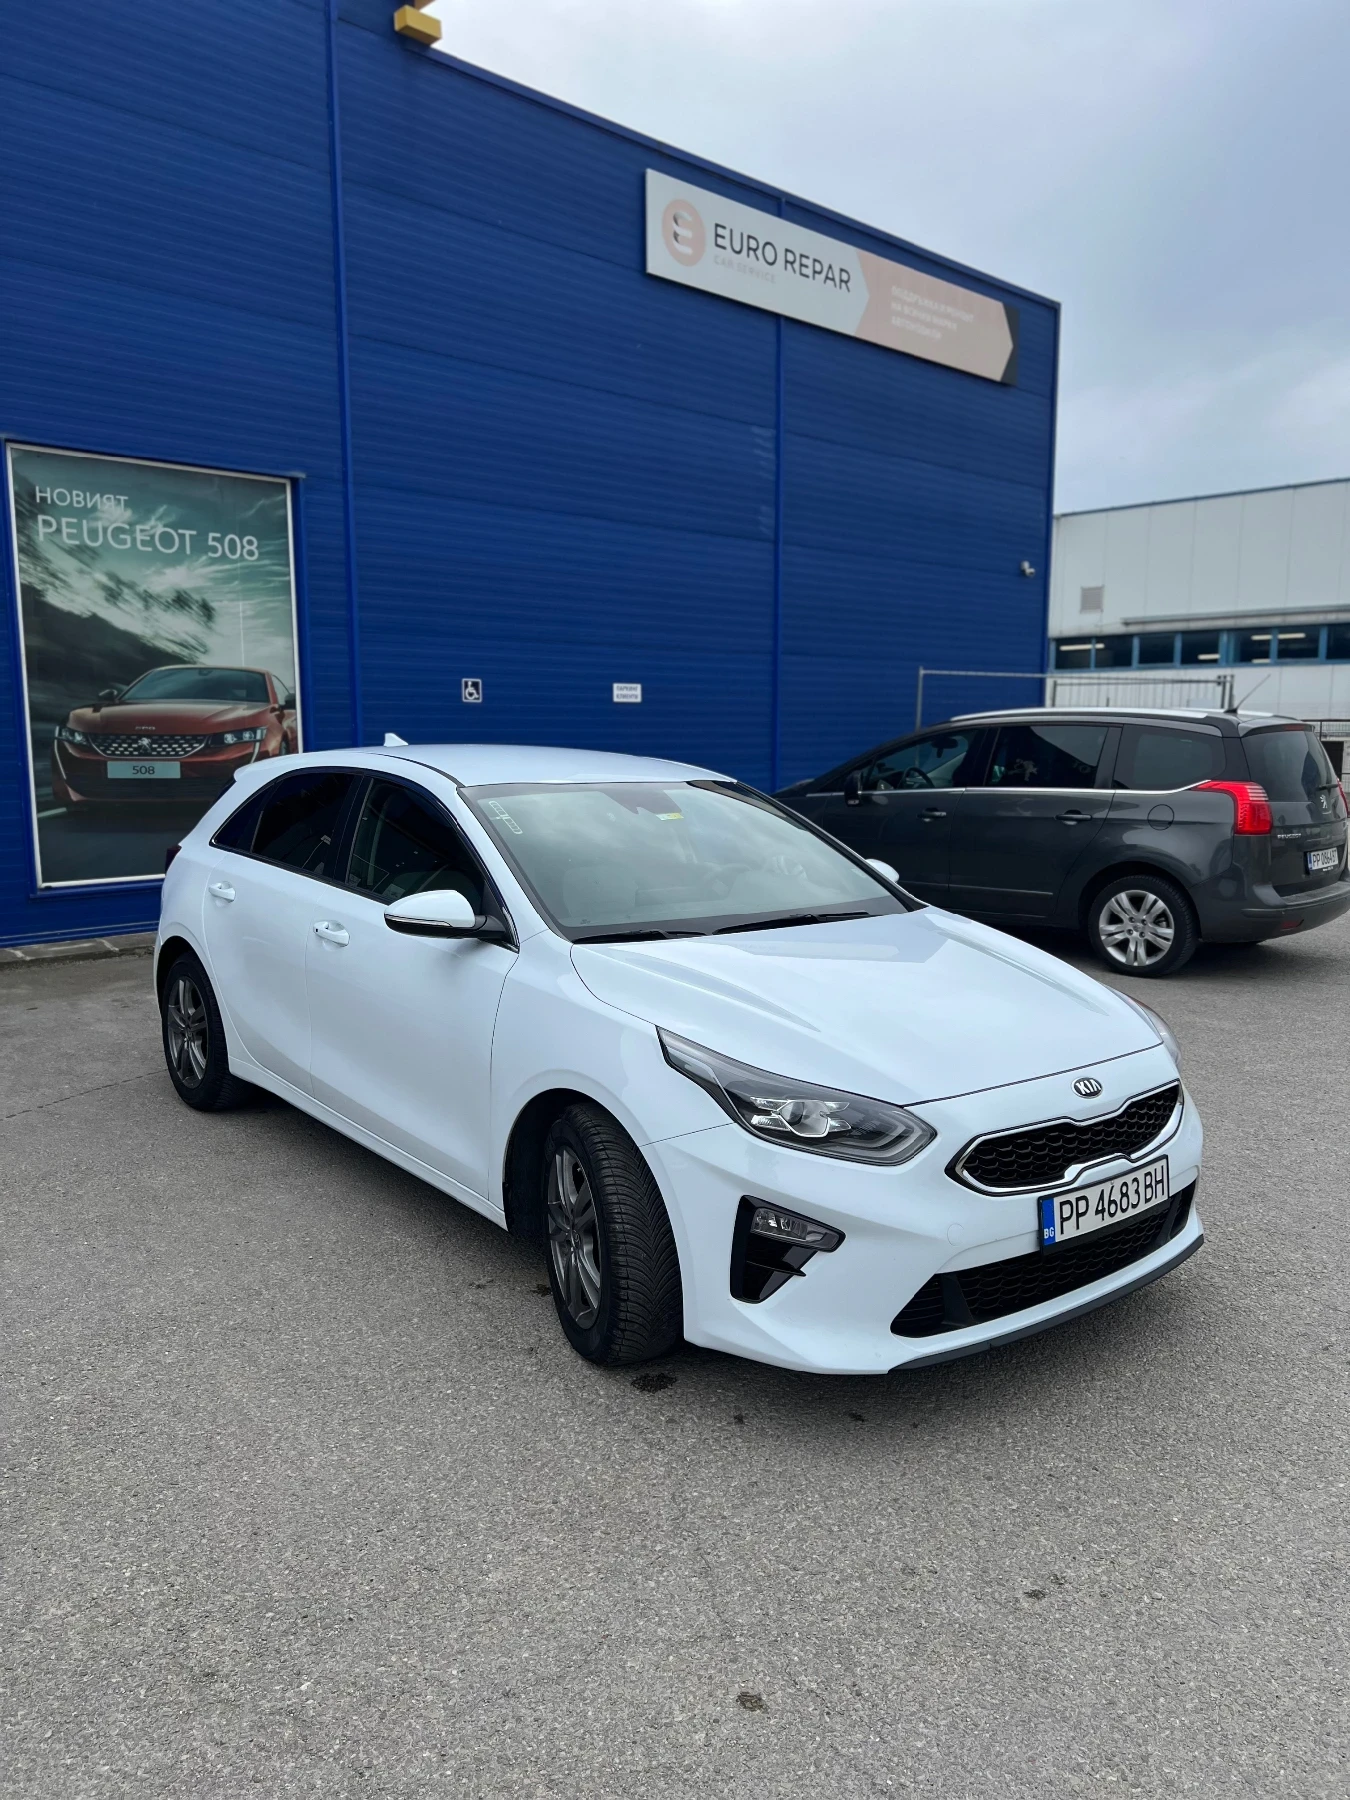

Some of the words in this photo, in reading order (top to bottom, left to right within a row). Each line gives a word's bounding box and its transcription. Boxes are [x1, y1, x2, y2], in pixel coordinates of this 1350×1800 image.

[713, 254, 734, 270] CAR
[736, 262, 776, 284] SERVICE
[714, 222, 778, 266] EURO
[784, 248, 851, 293] REPAR
[35, 485, 129, 511] НОВИЯТ
[37, 514, 197, 555] PEUGEOT
[207, 532, 259, 561] 508
[132, 765, 155, 775] 508
[1075, 1079, 1102, 1095] KIA
[1059, 1195, 1090, 1235] PP
[1094, 1177, 1141, 1221] 4683
[1144, 1165, 1165, 1204] BH
[1043, 1226, 1055, 1239] BG
